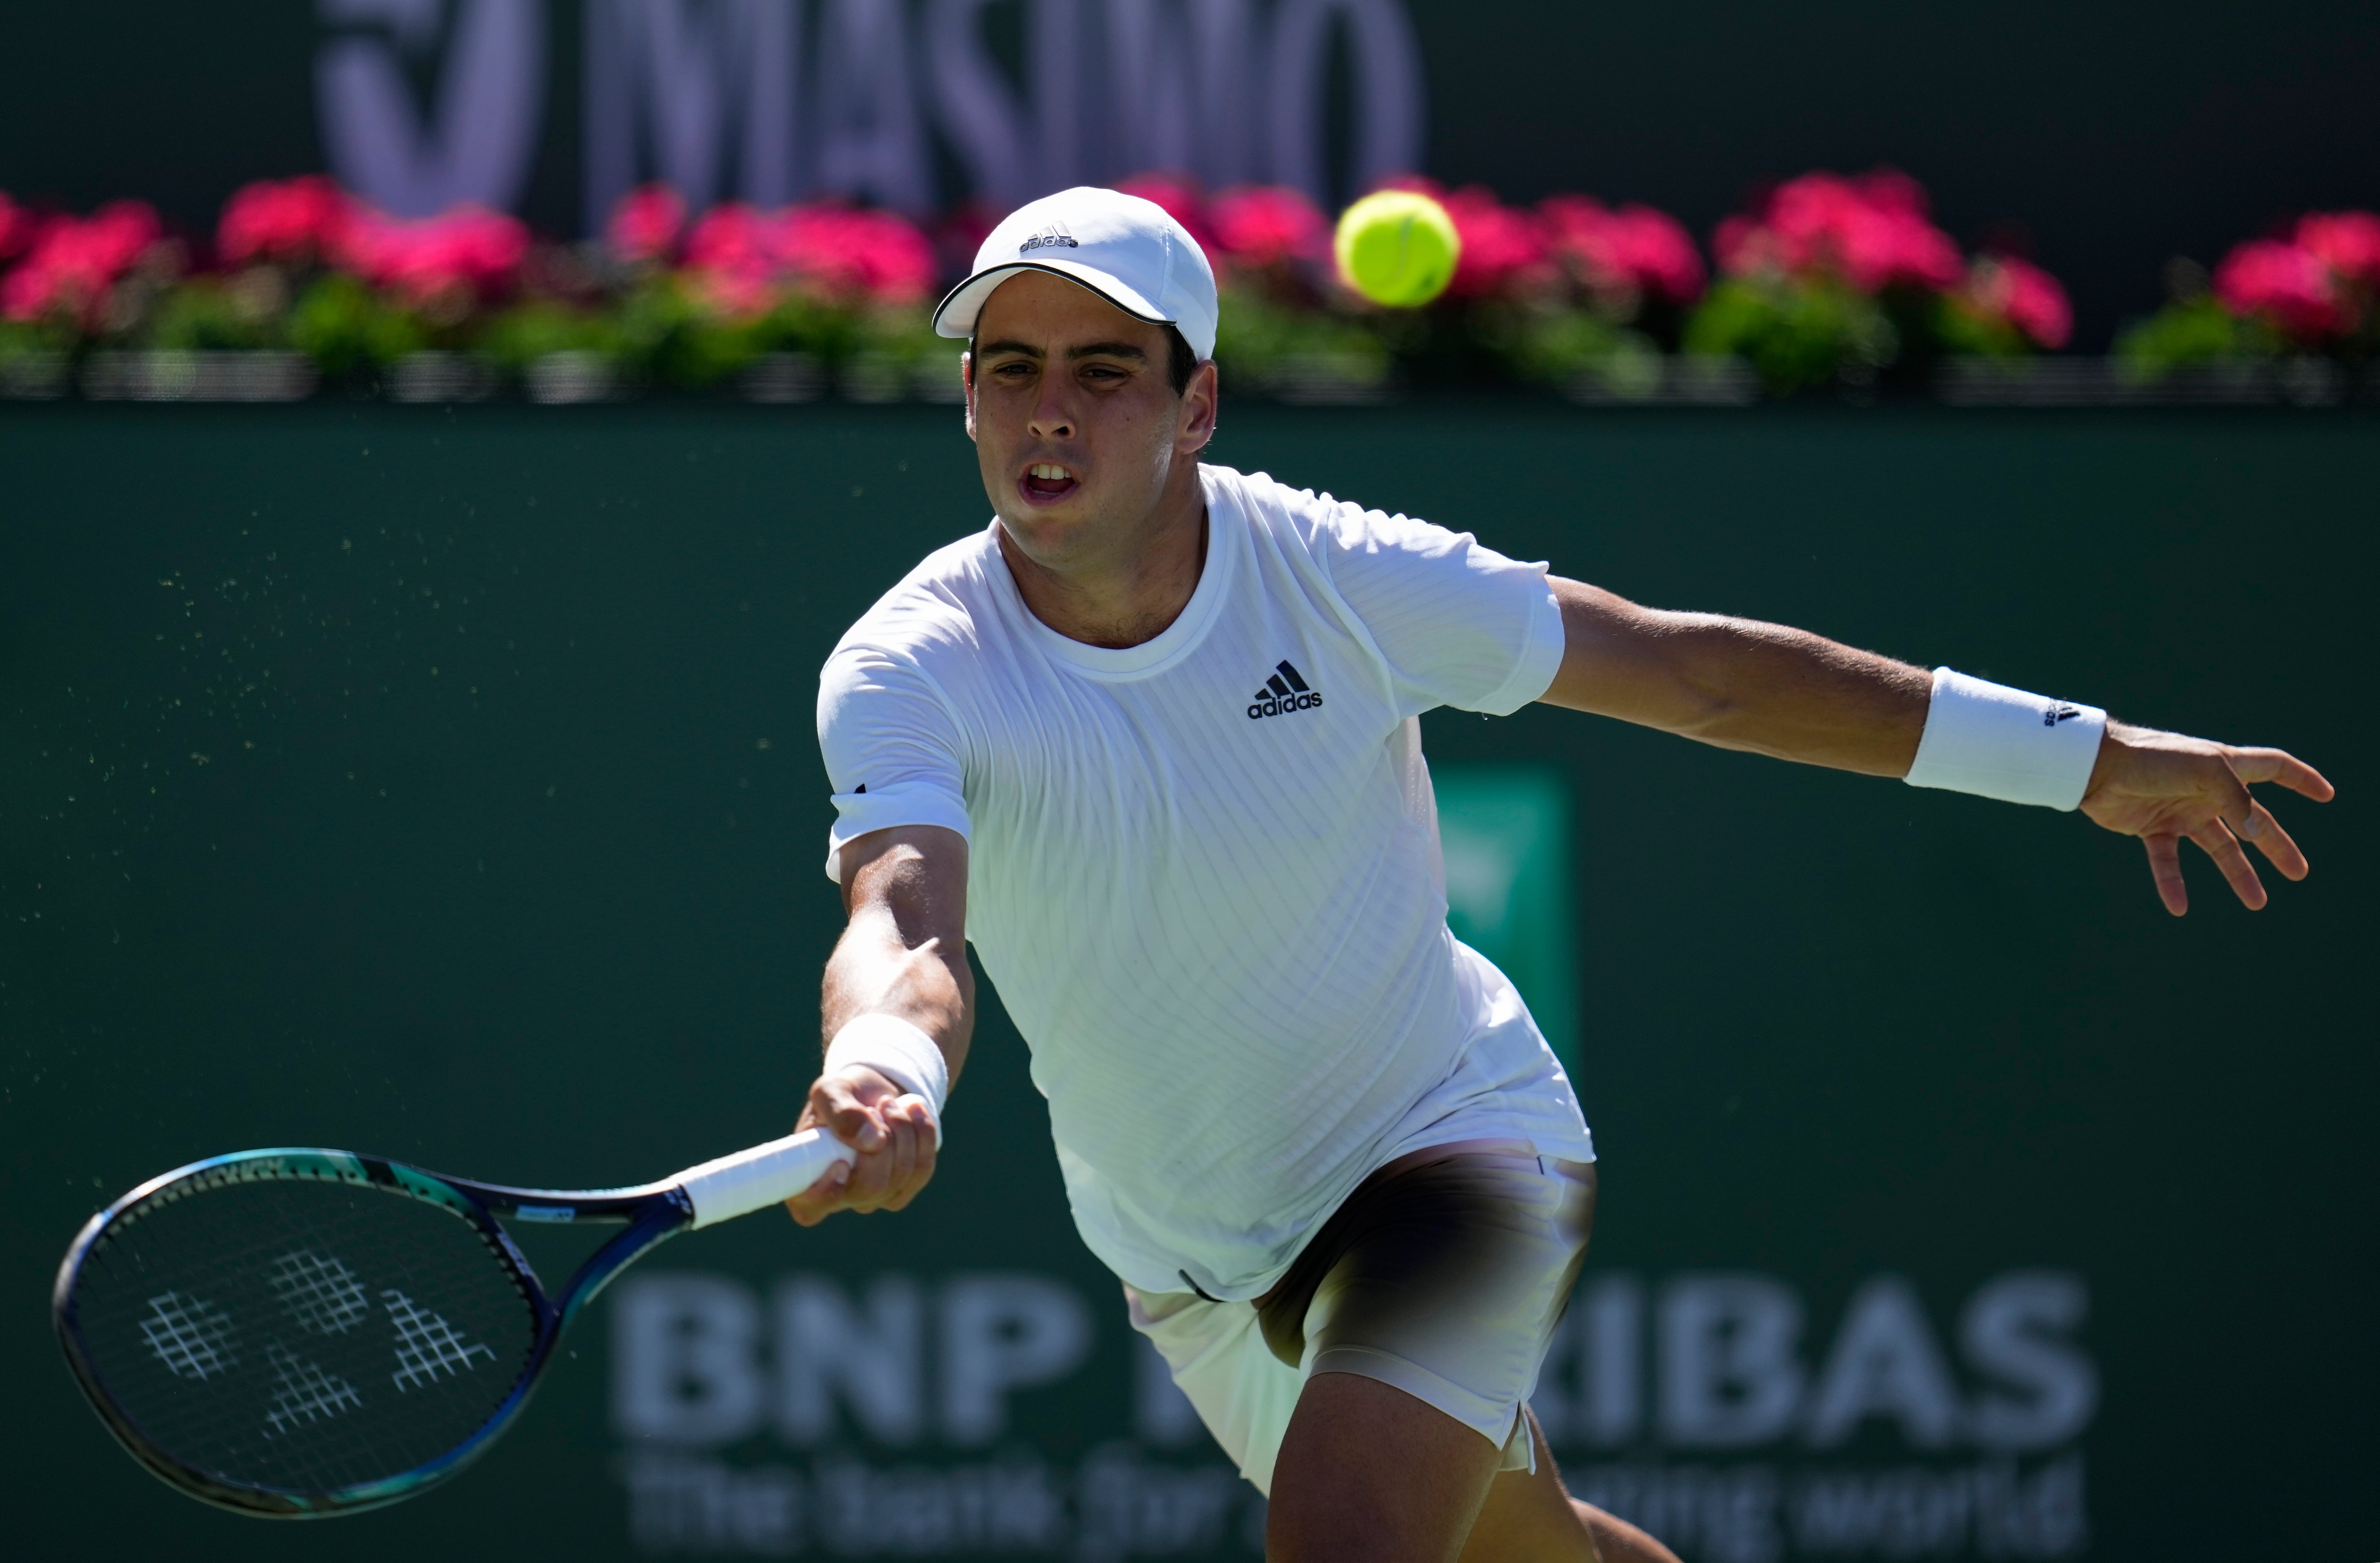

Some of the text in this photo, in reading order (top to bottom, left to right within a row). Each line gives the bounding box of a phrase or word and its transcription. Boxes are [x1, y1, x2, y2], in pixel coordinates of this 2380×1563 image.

[1019, 237, 1079, 252] adidas
[1247, 692, 1323, 719] adidas
[615, 1277, 1089, 1444] BNP
